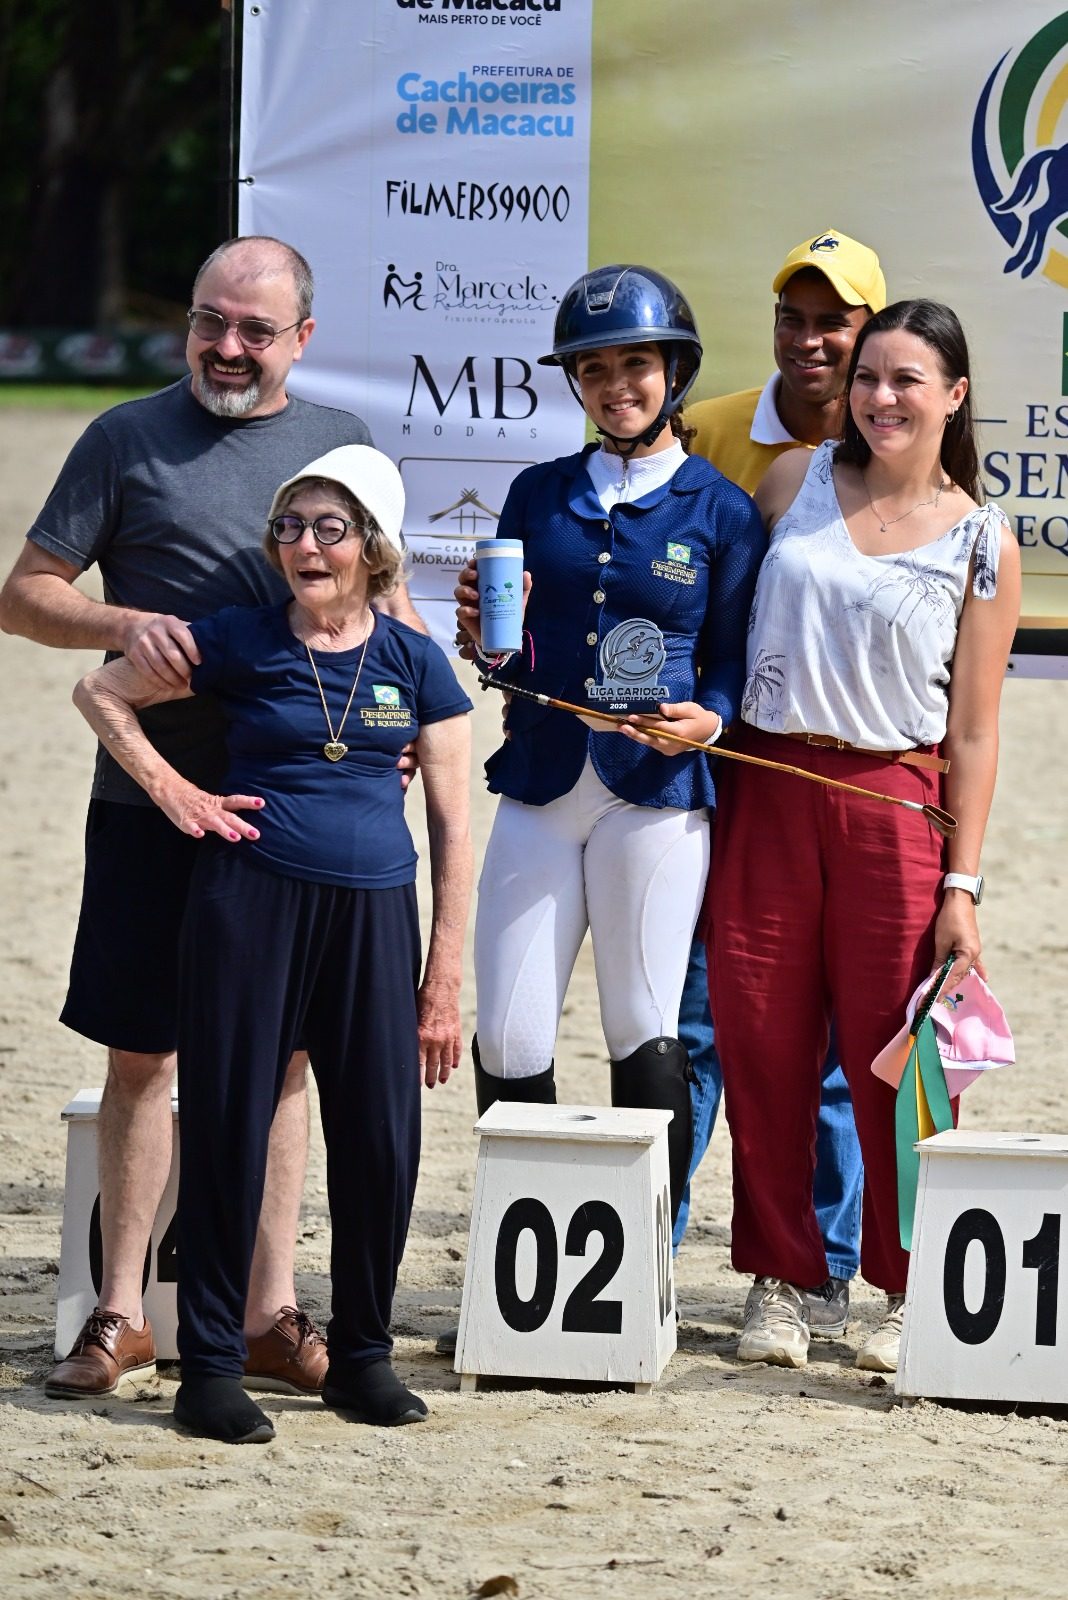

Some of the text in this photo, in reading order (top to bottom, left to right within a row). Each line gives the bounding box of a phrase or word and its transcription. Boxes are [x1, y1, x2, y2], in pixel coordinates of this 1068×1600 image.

[418, 14, 542, 26] MAIS PERTO DE VOCÊ
[472, 65, 574, 77] PREFEITURA DE
[396, 71, 576, 105] Cachoeiras
[396, 103, 574, 137] de Macacu
[436, 274, 548, 300] Marcele
[444, 315, 536, 325] fisioterapeuta
[404, 354, 538, 419] MB
[402, 423, 538, 439] MODAS
[412, 551, 469, 565] MORADA
[589, 687, 666, 696] LIGA CARIOCA
[361, 711, 411, 719] DESEMPENHO
[494, 1197, 625, 1334] 02
[943, 1208, 1061, 1345] 01
